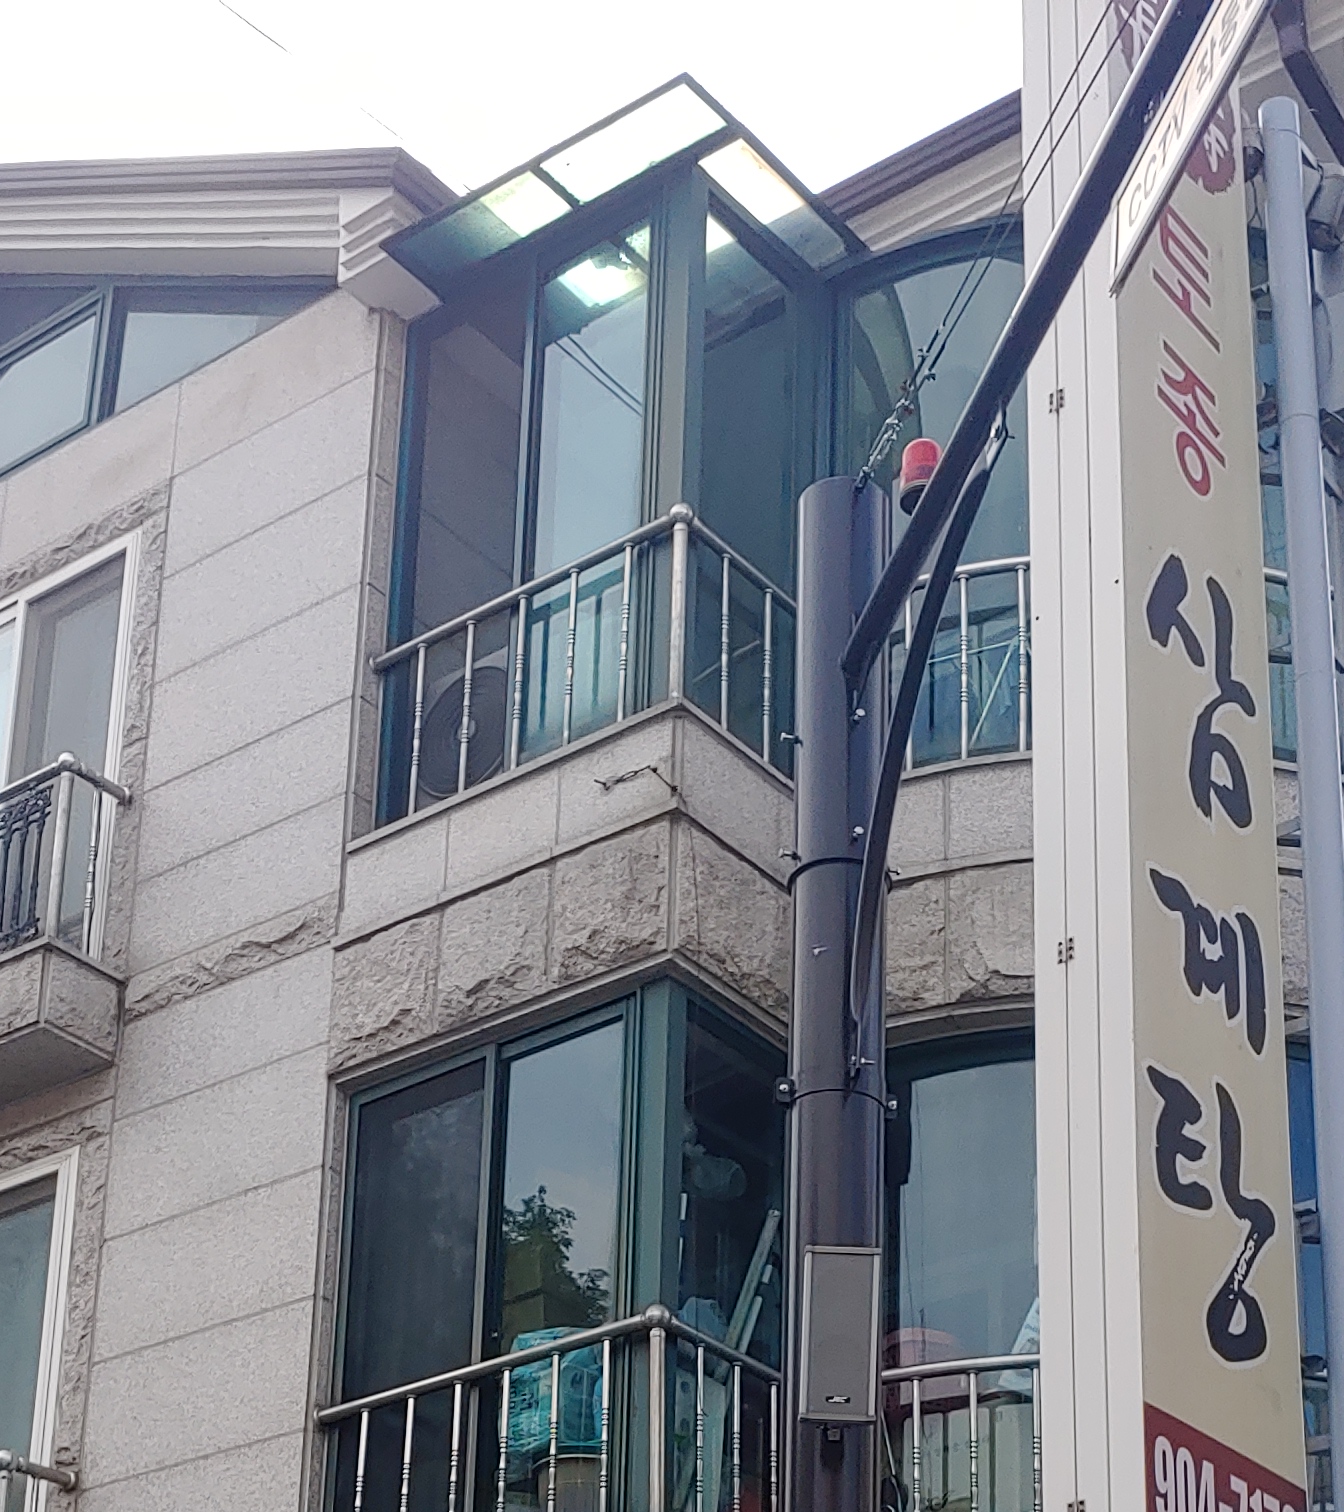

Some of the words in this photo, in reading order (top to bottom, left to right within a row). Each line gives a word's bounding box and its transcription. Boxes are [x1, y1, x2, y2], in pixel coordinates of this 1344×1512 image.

[1128, 86, 1189, 228] CCTV
[1153, 203, 1226, 498] 토종
[1146, 554, 1276, 1363] 삼계탕
